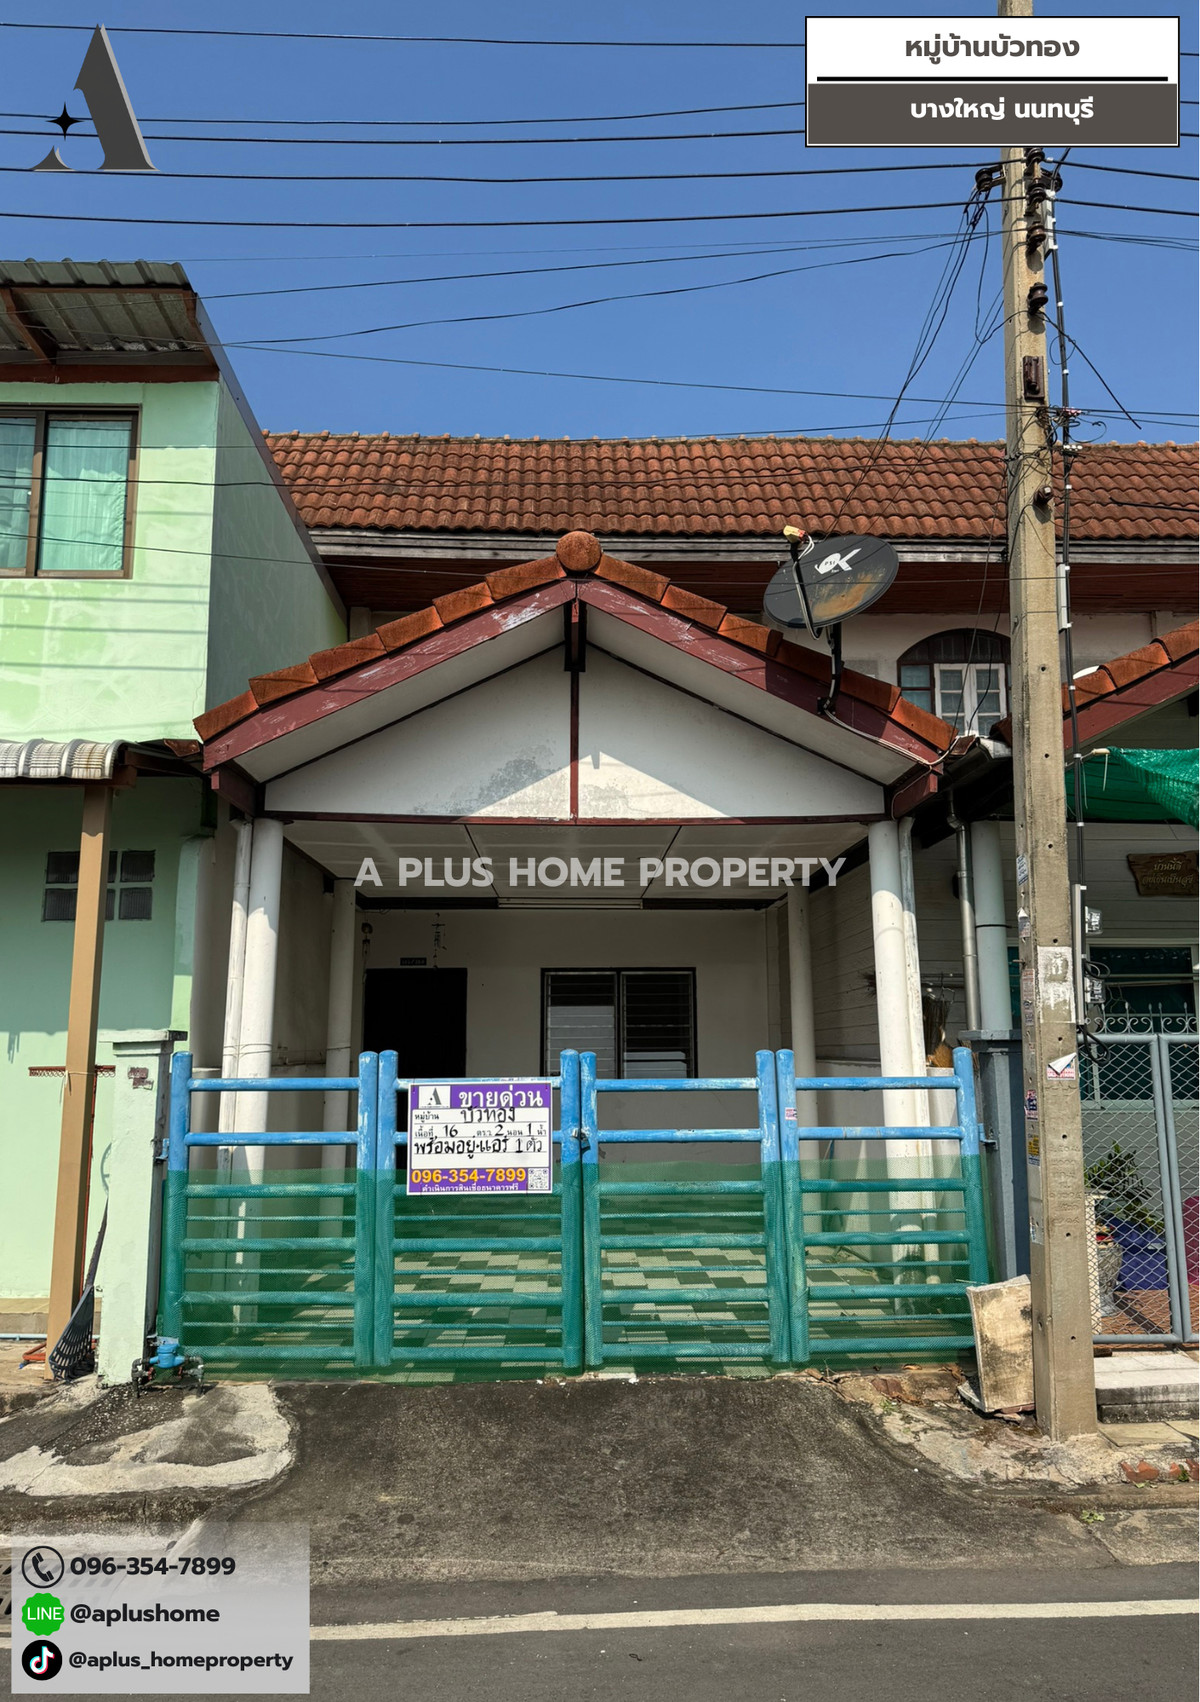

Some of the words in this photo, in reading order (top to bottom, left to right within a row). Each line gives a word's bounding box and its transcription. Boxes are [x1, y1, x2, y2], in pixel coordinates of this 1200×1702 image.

[459, 1085, 543, 1107] ขายด่วน
[414, 1111, 439, 1123] หมู่บ้าน
[460, 1106, 516, 1123] บัวทอง
[414, 1125, 434, 1138] เนื้อที่
[443, 1124, 458, 1138] 16
[495, 1124, 504, 1136] 2
[507, 1128, 523, 1136] นอน
[526, 1123, 532, 1136] 1
[515, 1138, 523, 1153] 1
[411, 1168, 526, 1183] 096-354-7899
